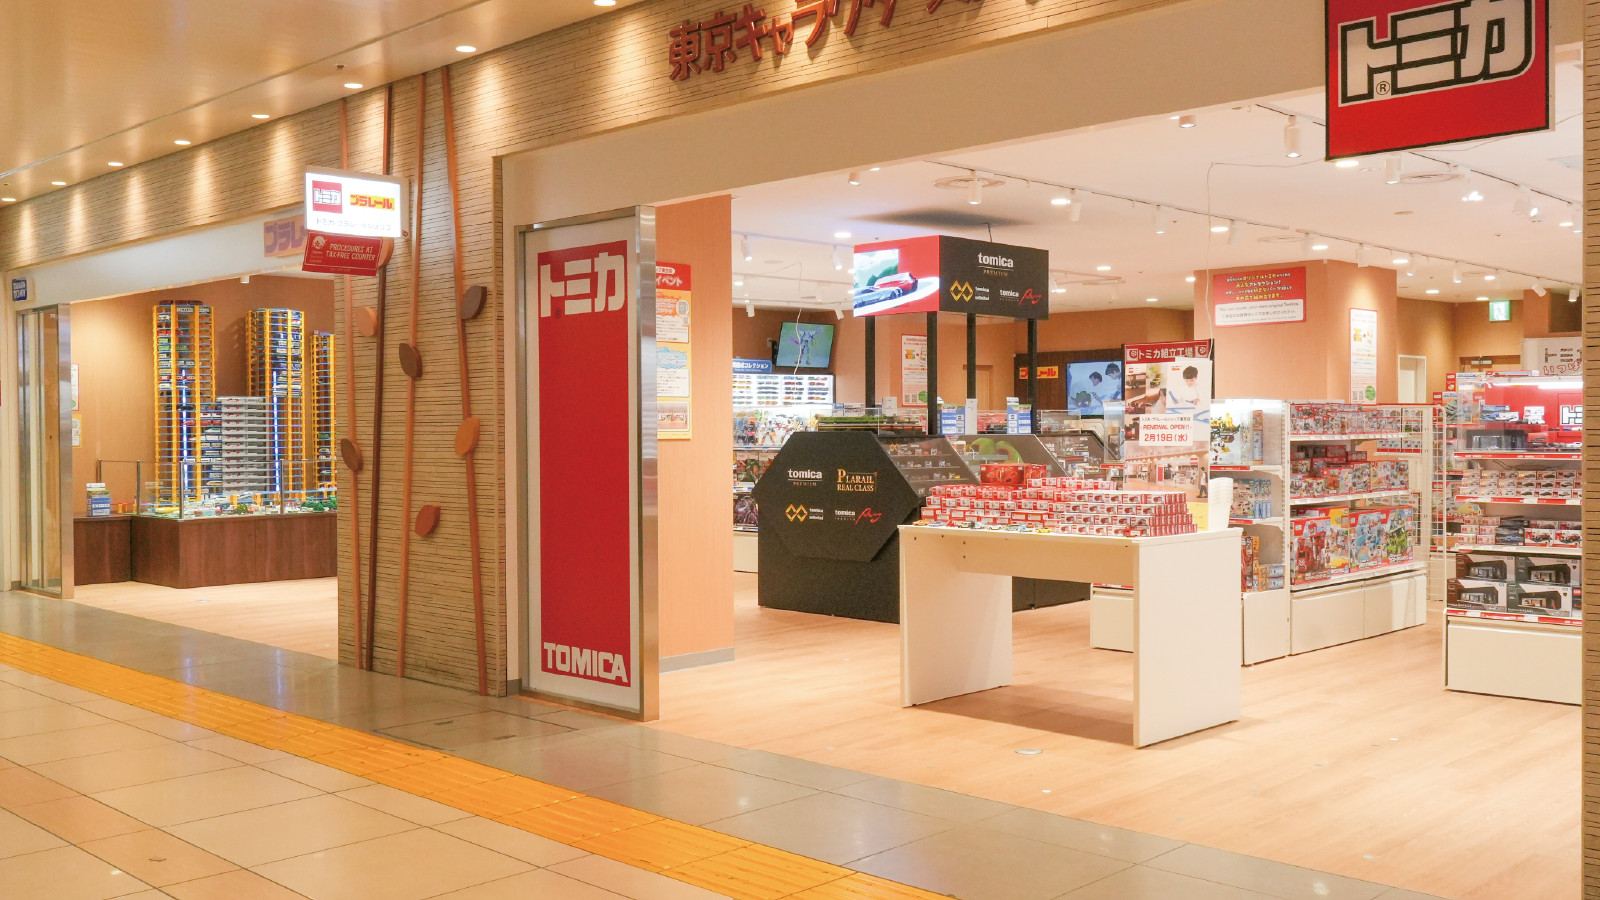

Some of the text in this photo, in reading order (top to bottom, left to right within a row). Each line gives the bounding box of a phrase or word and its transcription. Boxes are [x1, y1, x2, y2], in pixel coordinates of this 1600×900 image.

[1338, 0, 1535, 107] トミカ
[313, 188, 342, 206] トミカ
[350, 194, 393, 210] プラレール
[326, 250, 350, 260] TAX-FREE
[351, 252, 376, 261] COUNTER
[329, 243, 374, 254] PROCEDURES AT
[978, 253, 1014, 268] tomica
[540, 251, 625, 318] トミカ
[1000, 289, 1019, 297] tomica
[1139, 347, 1194, 359] トミカ組立工場
[788, 469, 822, 479] tomica
[837, 469, 875, 483] PLARAIL
[855, 484, 874, 492] CLASS
[543, 641, 629, 683] TOMICA
